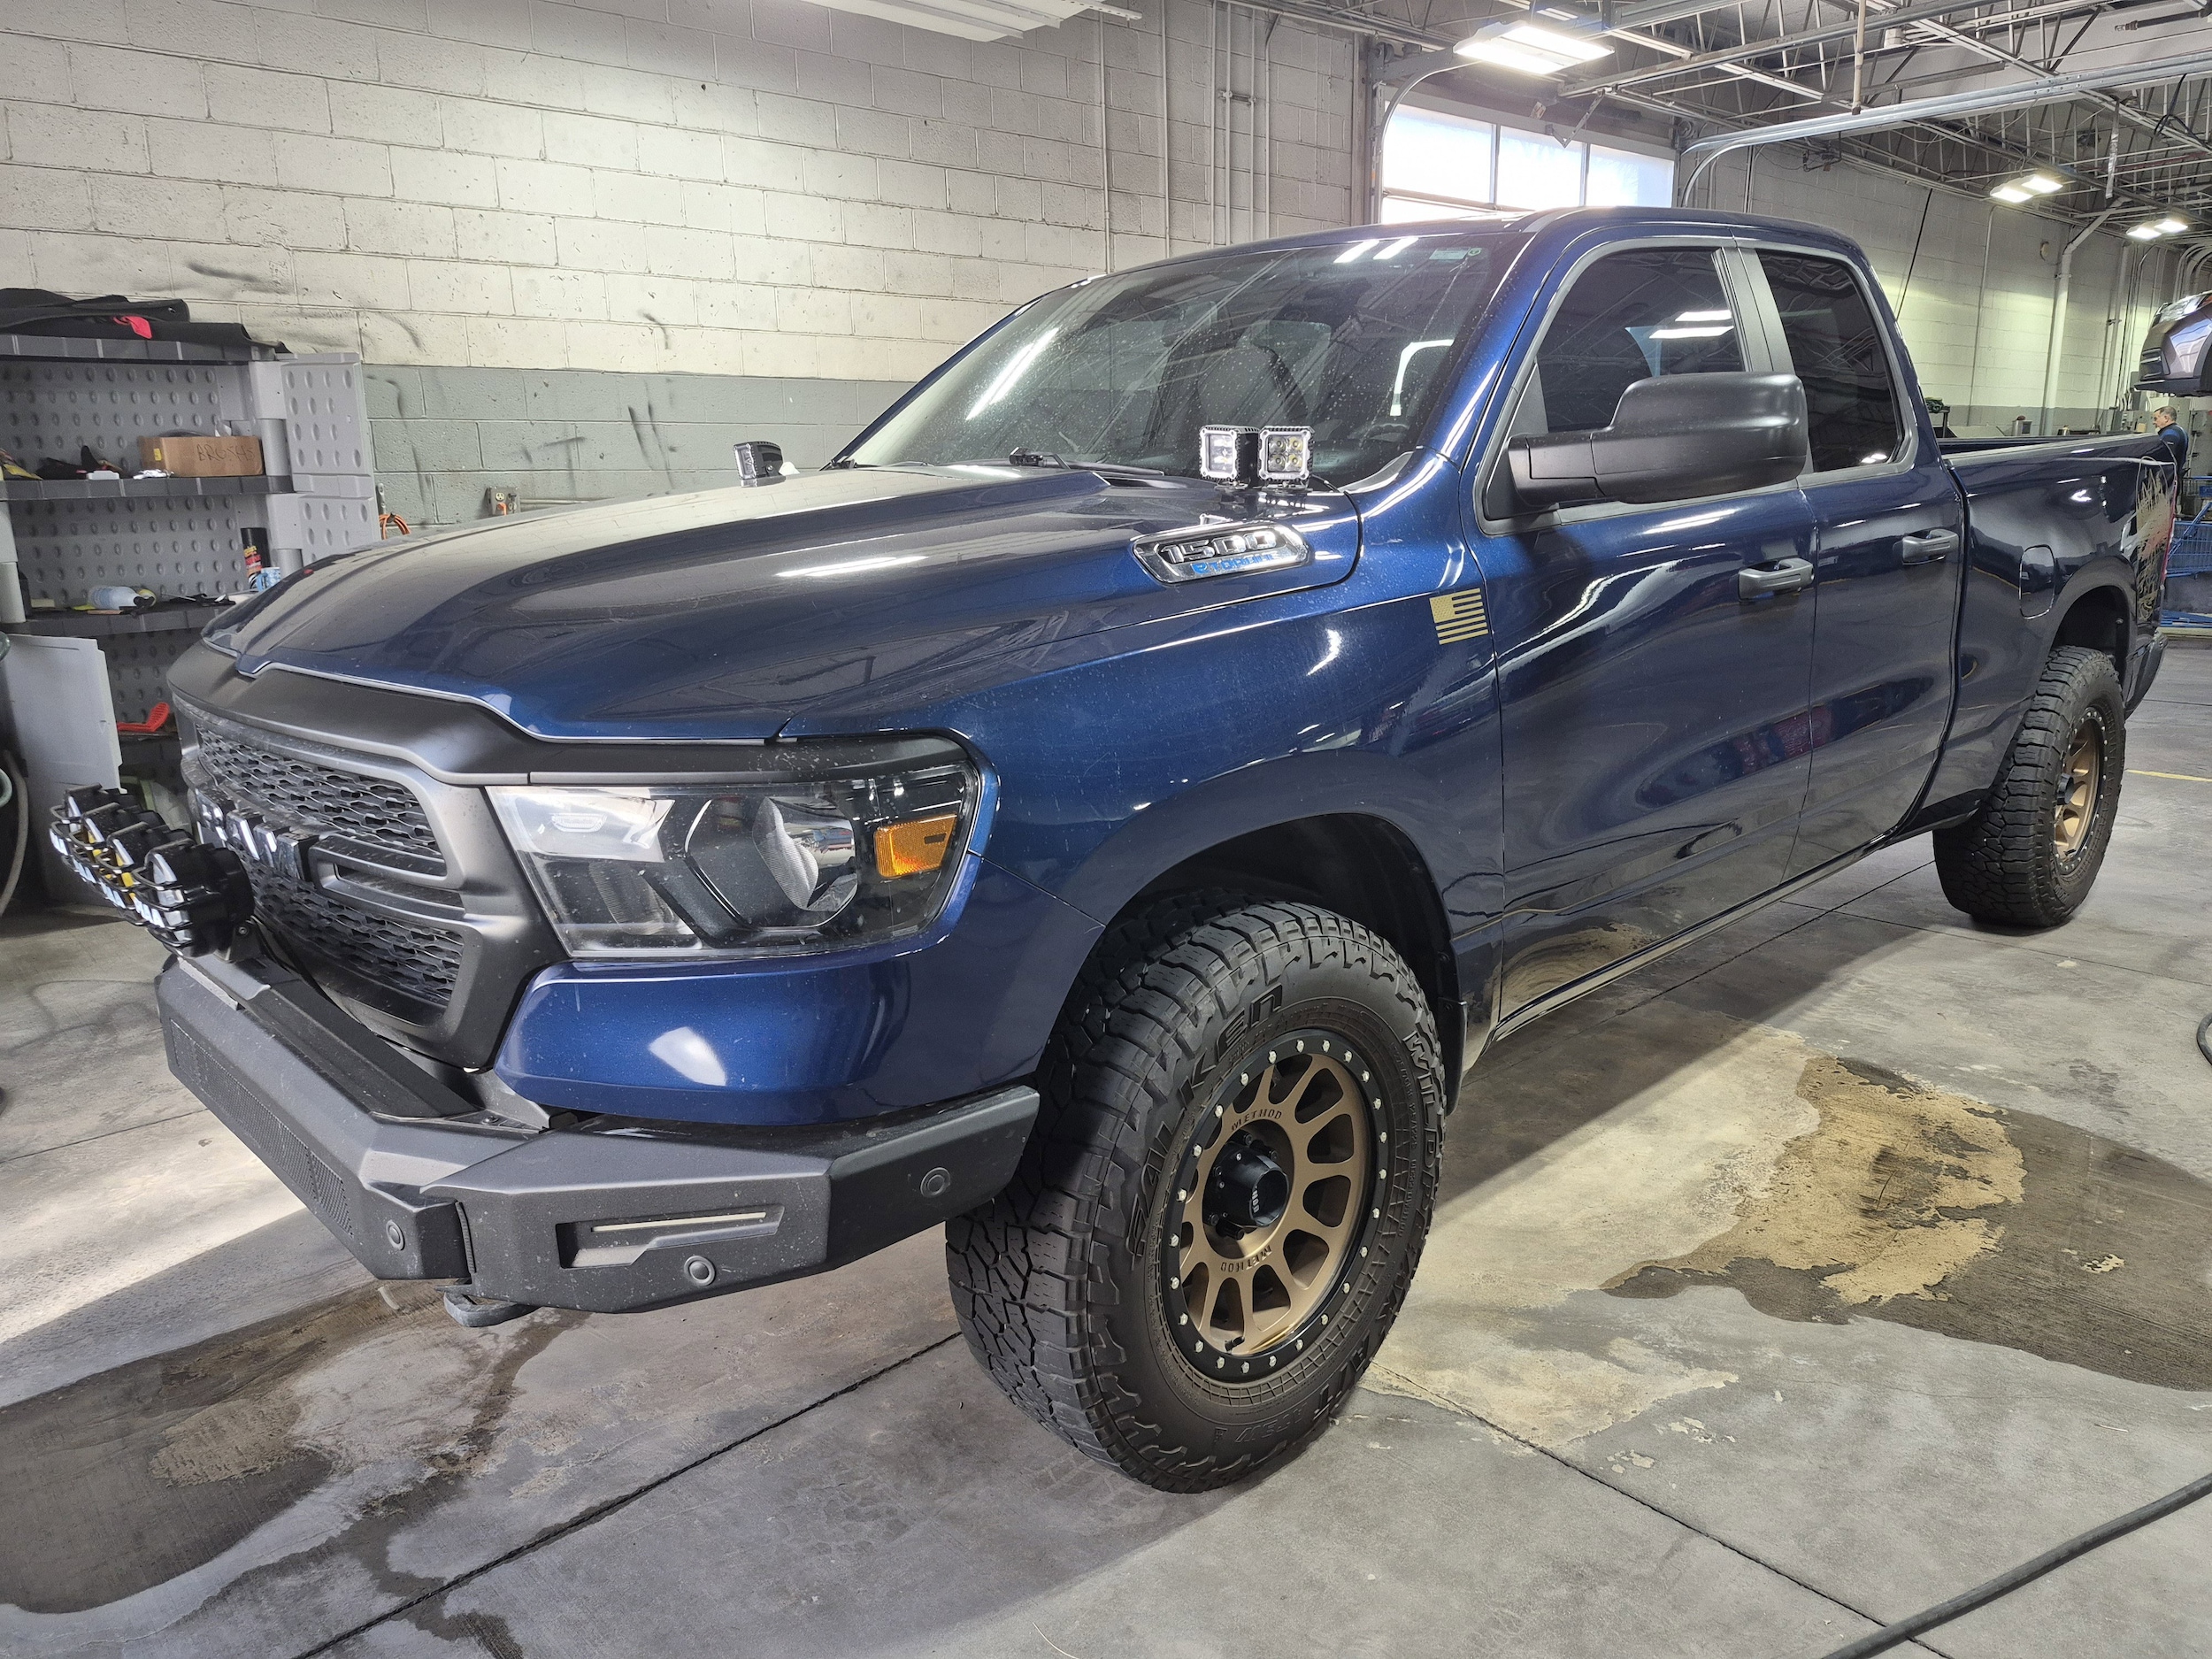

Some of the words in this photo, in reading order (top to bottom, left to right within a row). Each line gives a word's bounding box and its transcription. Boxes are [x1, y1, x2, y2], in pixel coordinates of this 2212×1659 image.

[1161, 531, 1277, 565] 1500
[196, 788, 305, 882] RAM
[1125, 982, 1283, 1271] FALKEN
[1231, 1108, 1283, 1133] METHOD
[1220, 1245, 1273, 1273] METHOD
